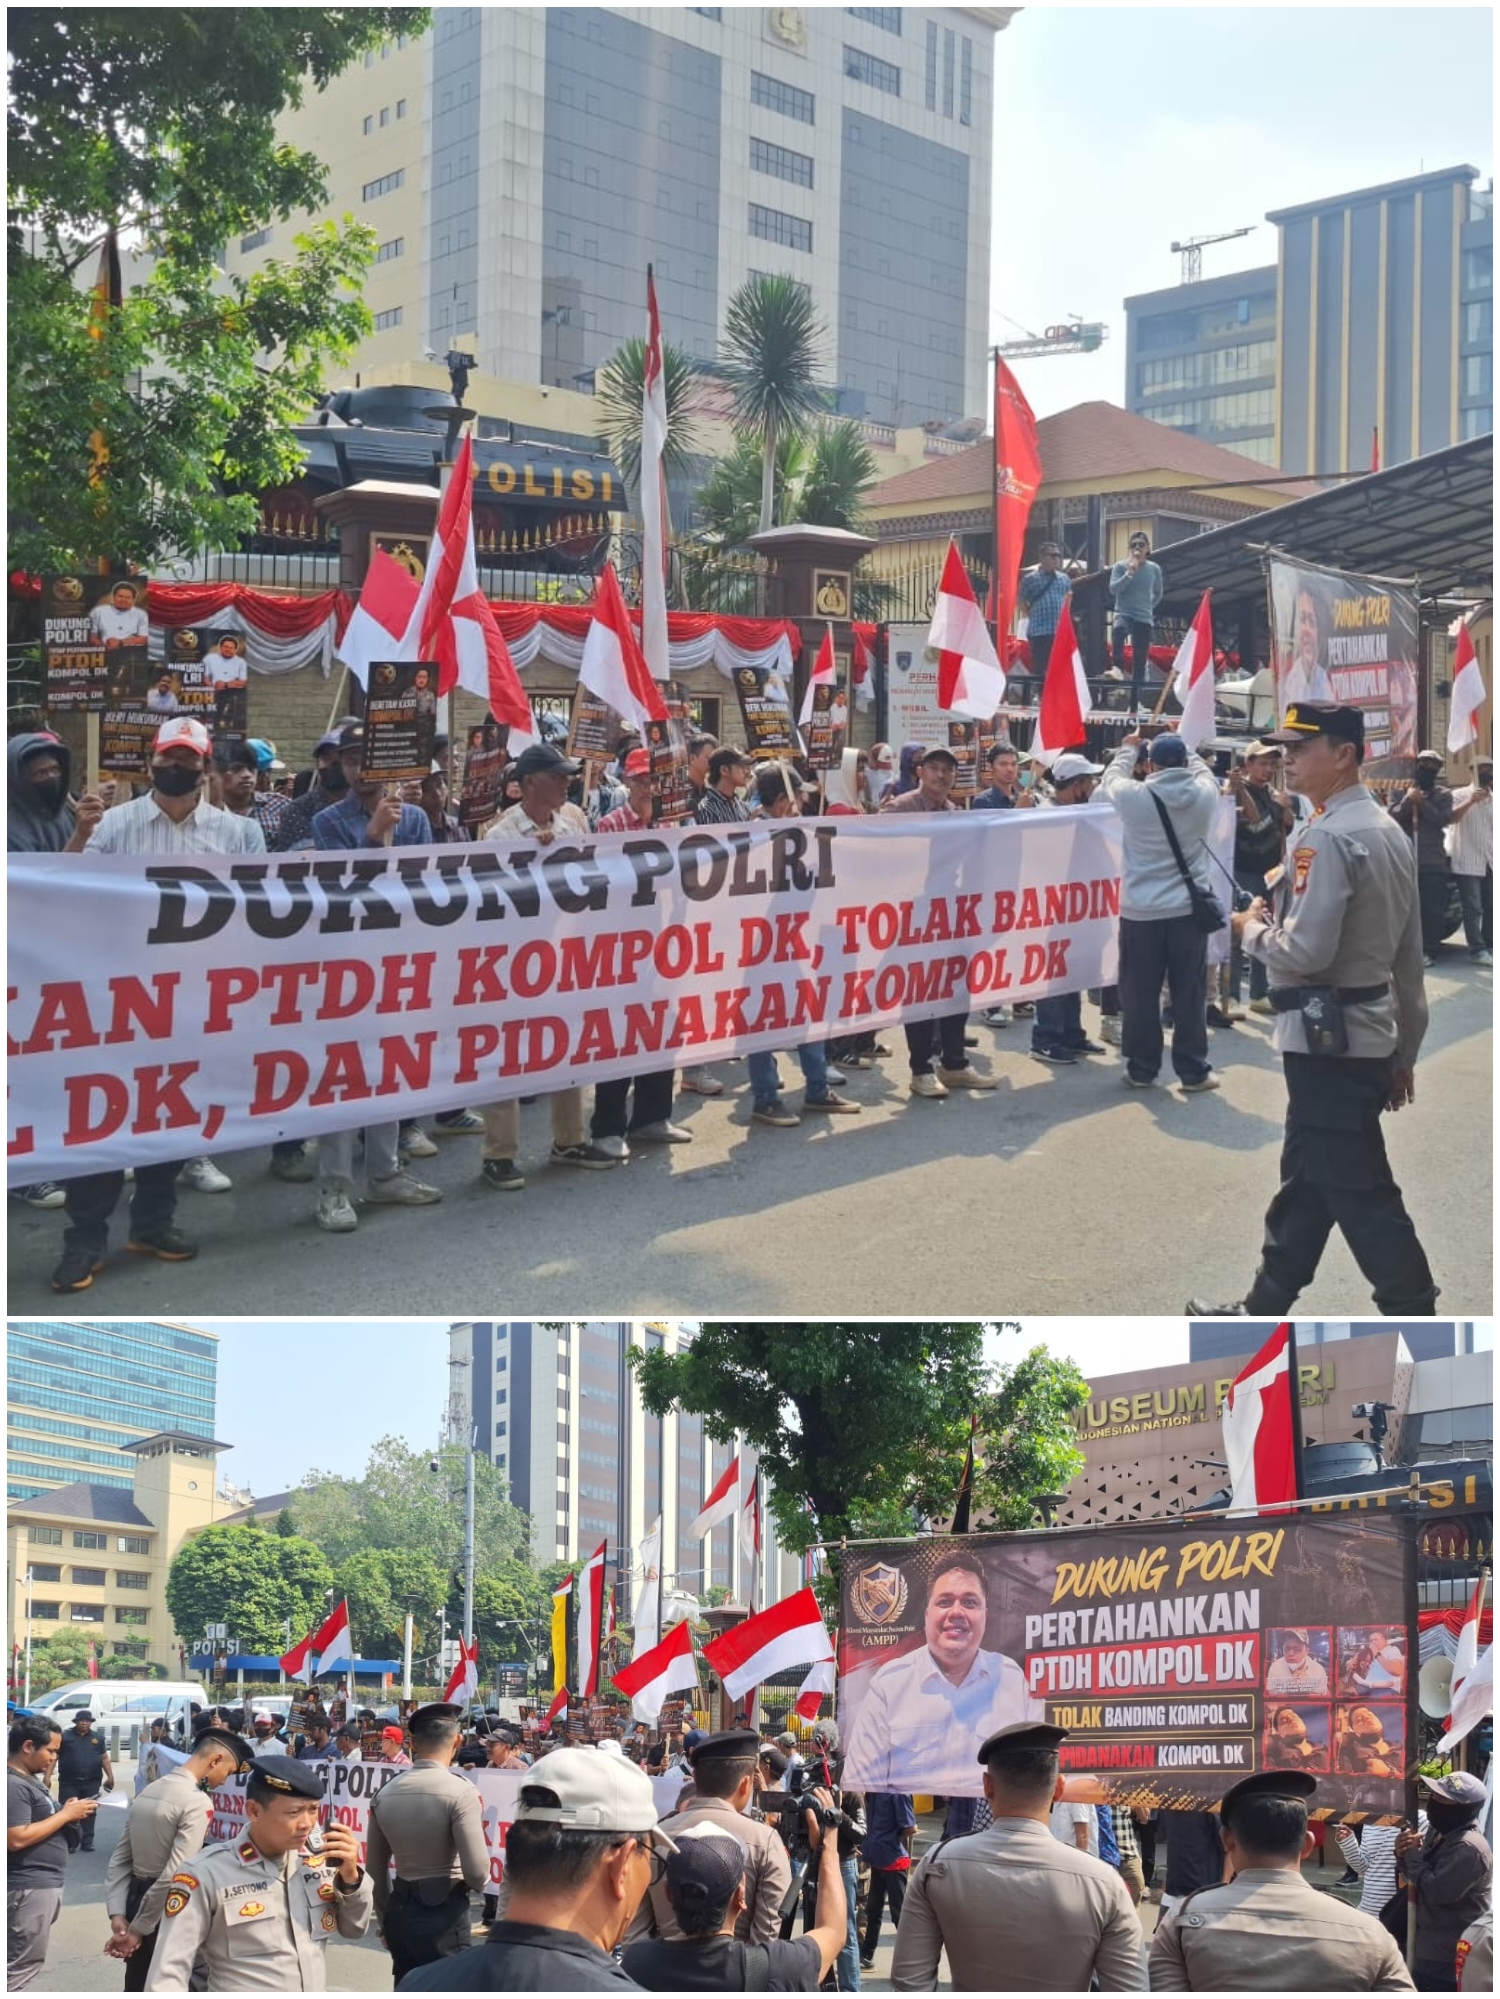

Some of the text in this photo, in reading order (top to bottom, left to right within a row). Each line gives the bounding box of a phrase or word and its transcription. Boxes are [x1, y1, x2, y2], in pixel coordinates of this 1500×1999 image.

[45, 618, 91, 631] DUKUNG
[45, 630, 88, 644] POLRI
[49, 653, 105, 668] PTDH
[48, 668, 91, 678] KOMPOL
[183, 672, 202, 683] LRI
[908, 673, 937, 681] PERH
[181, 692, 215, 704] TDH
[145, 825, 837, 945] DUKUNG POLRI
[7, 877, 1121, 1057] AN PTDH KOMPOL DK, TOLAK BANDIN
[63, 938, 1071, 1146] DK, DAN PIDANAKAN KOMPOL DK
[1069, 1361, 1335, 1430] MUSEUM PRI
[1143, 1413, 1209, 1431] NATIONAL
[1051, 1528, 1285, 1605] DUKUNG POLRI
[1025, 1589, 1260, 1650] PERTAHANKAN
[193, 1639, 240, 1656] POLISI
[862, 1634, 899, 1647] (AMPP)
[1029, 1640, 1255, 1693] PTDH KOMPOL DK
[1052, 1703, 1248, 1729] TOLAK BANDING KOMPOL DK
[1059, 1744, 1244, 1768] PIDANAKAN KOMPOL DK
[333, 1764, 407, 1798] POLR
[210, 1791, 245, 1816] KAN
[224, 1881, 268, 1899] J.SETYONO
